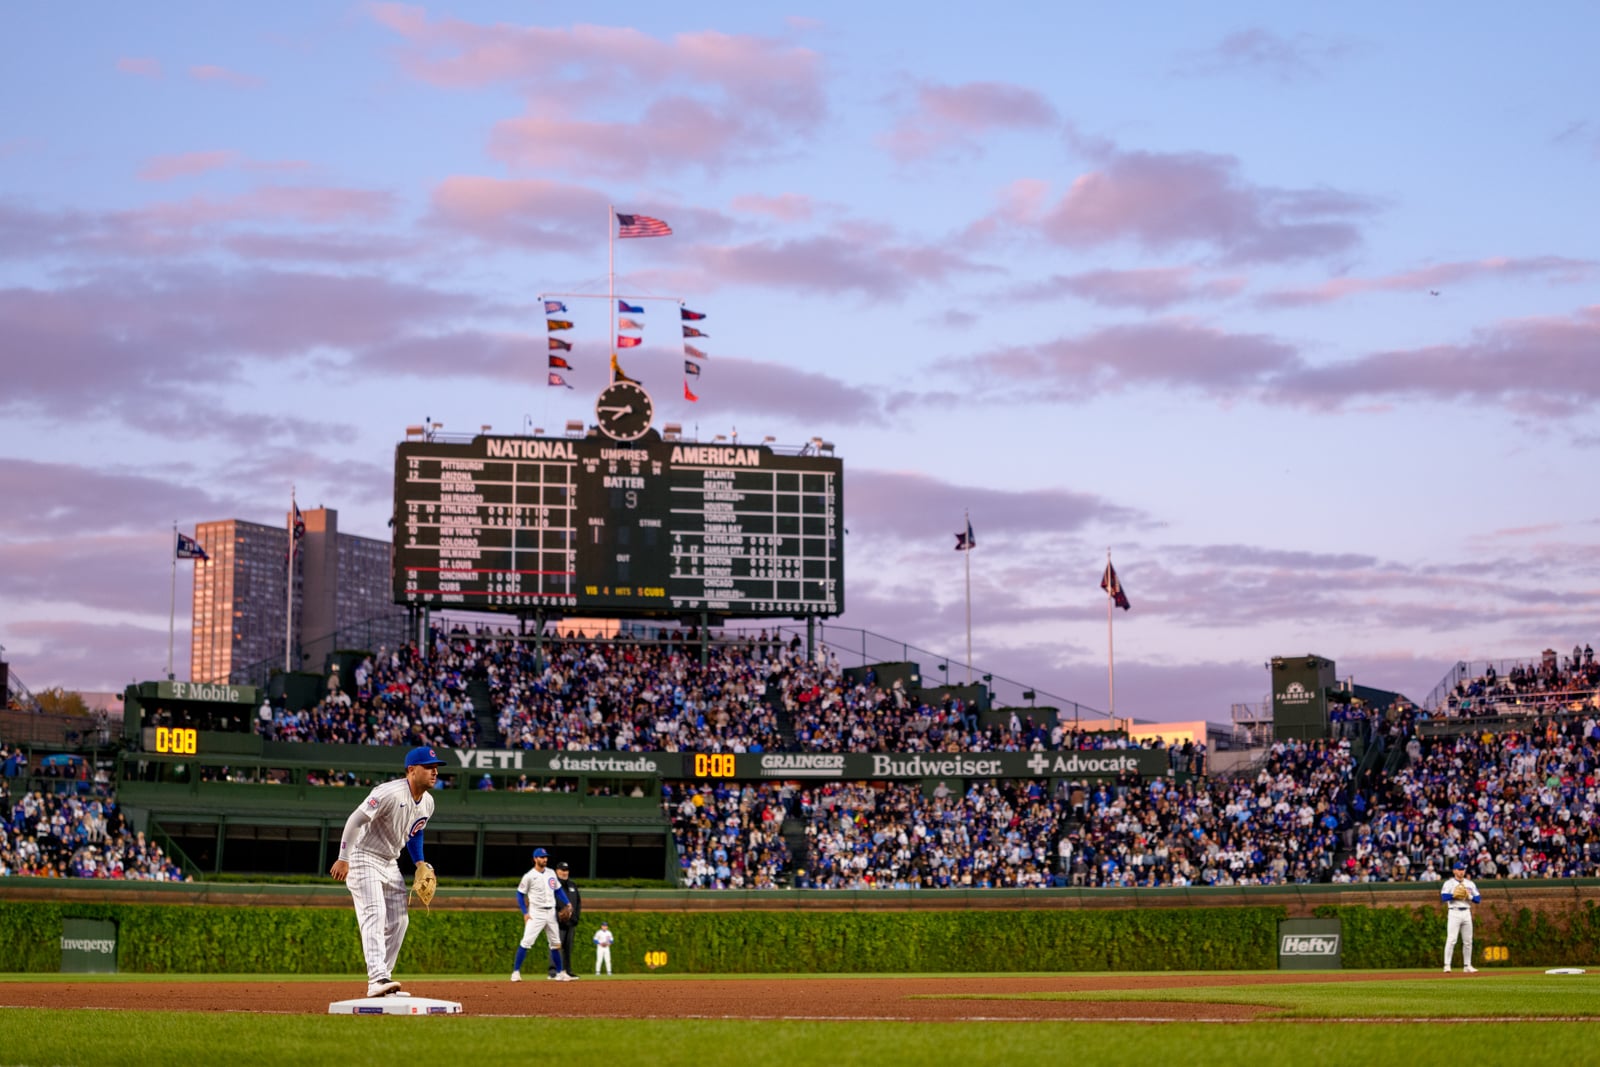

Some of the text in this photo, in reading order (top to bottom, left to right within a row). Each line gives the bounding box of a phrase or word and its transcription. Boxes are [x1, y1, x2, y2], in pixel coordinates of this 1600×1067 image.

[487, 439, 578, 459] NATIONAL
[600, 448, 649, 461] UMPIRES
[670, 446, 759, 466] AMERICAN
[441, 461, 484, 471] PITTSBURGH
[441, 471, 472, 481] ARIZONA
[703, 470, 736, 480] ATLANTA
[440, 482, 455, 492] SAN
[455, 483, 476, 493] DIEGO
[603, 476, 645, 489] BATTER
[703, 480, 733, 491] SEATTLE
[440, 493, 453, 503] SAN
[453, 494, 484, 504] FRANCISCO
[625, 490, 638, 509] 9
[440, 505, 477, 515] ATHLETICS
[440, 515, 482, 526] PHILADELPHIA
[588, 517, 605, 526] BALL
[639, 519, 662, 528] STRIKE
[704, 513, 737, 523] TORONTO
[440, 527, 455, 536] NEW
[455, 527, 473, 536] YORK
[703, 523, 743, 535] TAMPA BAY
[440, 537, 479, 548] COLORADO
[703, 535, 743, 545] CLEVELAND
[439, 548, 482, 559] MILWAUKEE
[703, 545, 729, 556] KANSAS
[729, 546, 745, 556] CITY
[616, 553, 630, 562] OUT
[703, 556, 732, 566] BOSTON
[451, 560, 473, 570] LOUIS
[439, 571, 479, 581] CINCINNATI
[703, 567, 732, 577] DETROIT
[439, 582, 461, 592] CUBS
[703, 578, 734, 588] CHICAGO
[644, 587, 665, 597] CUBS
[488, 595, 493, 605] 1
[496, 595, 503, 605] 2
[506, 595, 513, 605] 3
[514, 595, 521, 605] 4
[523, 596, 530, 605] 5
[532, 596, 539, 605] 6
[542, 596, 549, 606] 7
[551, 597, 558, 606] 8
[560, 597, 567, 607] 9
[567, 597, 577, 607] 10
[751, 602, 756, 611] 1
[760, 602, 766, 611] 2
[768, 602, 774, 612] 3
[776, 603, 783, 612] 4
[785, 603, 792, 612] 5
[793, 603, 800, 612] 6
[803, 604, 809, 612] 7
[811, 604, 818, 613] 8
[820, 604, 827, 613] 9
[828, 604, 837, 613] 10
[189, 683, 240, 702] Mobile
[1276, 692, 1316, 700] FARMERS
[156, 727, 197, 754] 0:08
[455, 751, 525, 769] YETI
[695, 754, 735, 777] 0:08
[761, 755, 845, 768] GRAINGER
[872, 755, 1001, 776] Budweiser
[1053, 755, 1139, 772] Advocate
[1285, 938, 1335, 955] Hefty
[644, 951, 668, 967] 400
